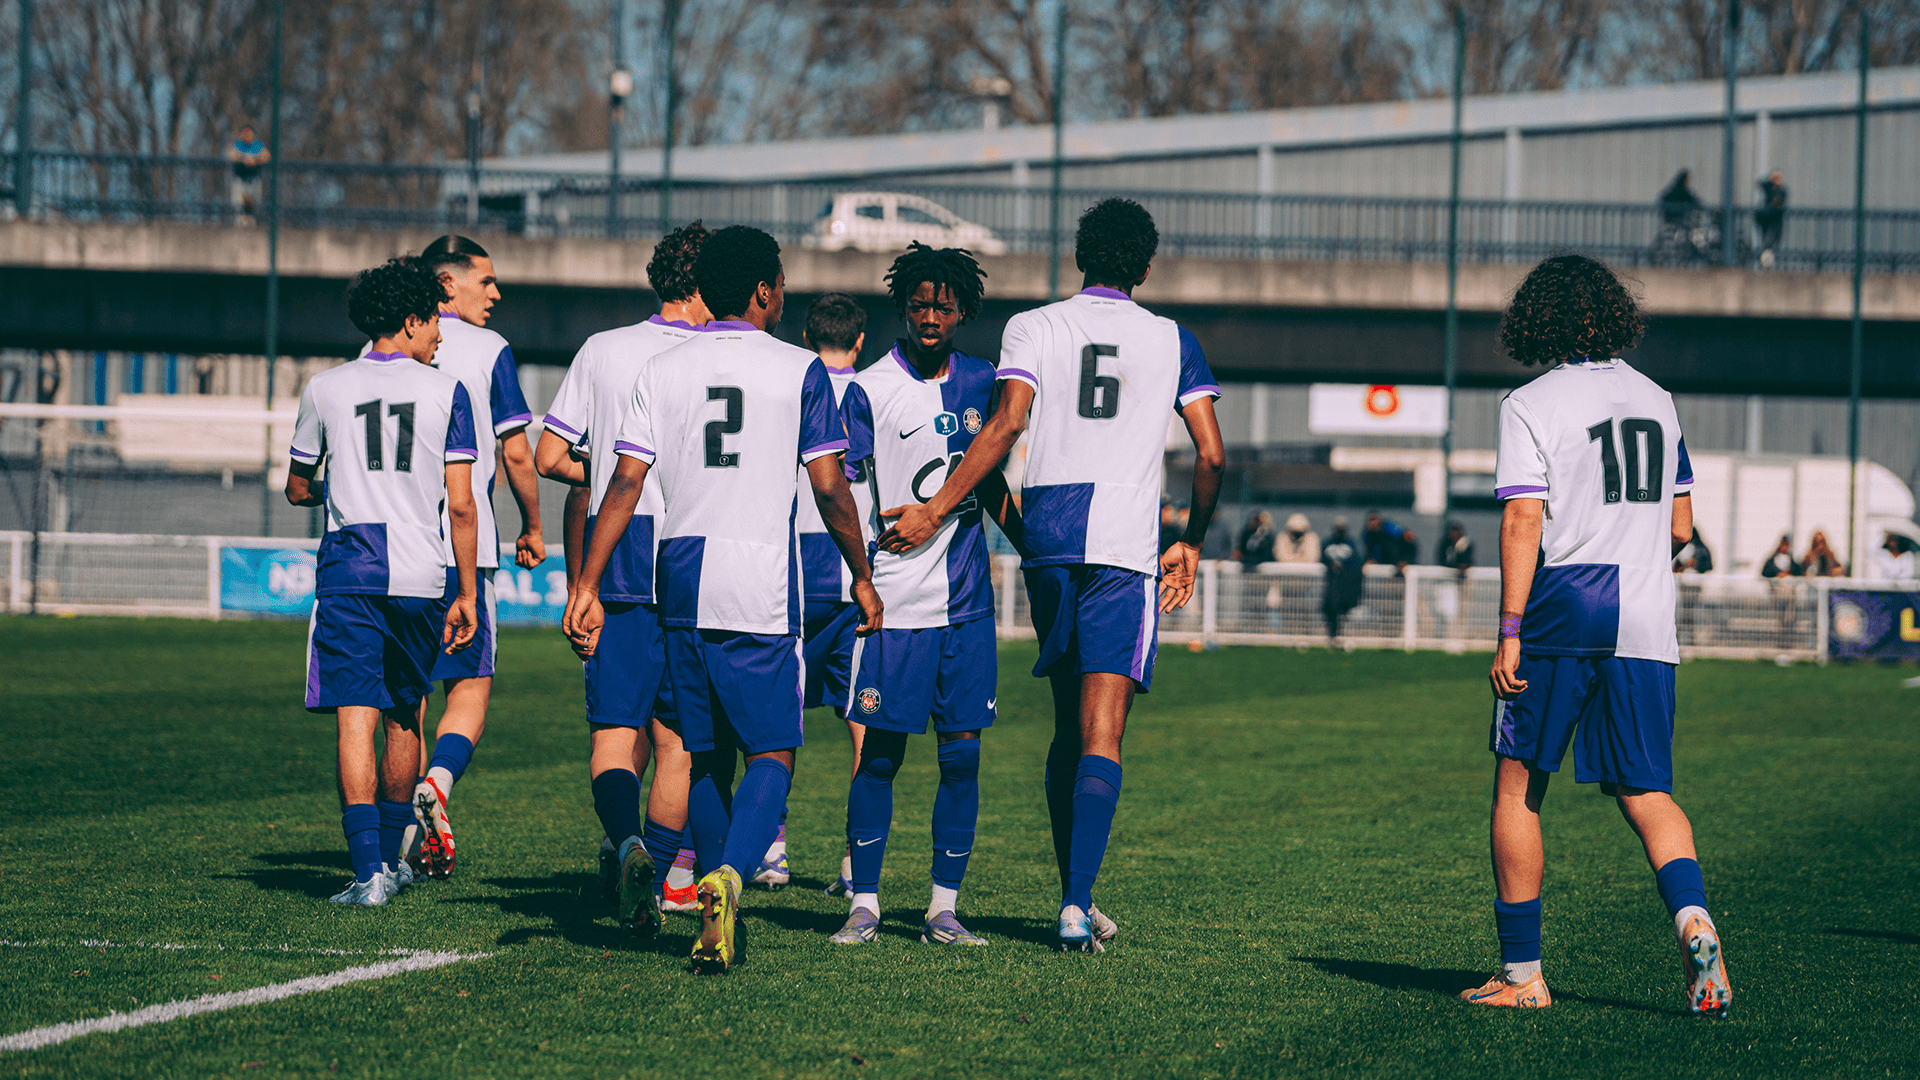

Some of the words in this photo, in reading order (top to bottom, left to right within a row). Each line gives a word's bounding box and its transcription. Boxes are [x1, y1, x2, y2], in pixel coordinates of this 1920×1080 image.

[1076, 342, 1122, 420] 6
[354, 398, 416, 473] 11
[703, 385, 745, 468] 2
[1586, 416, 1665, 505] 10
